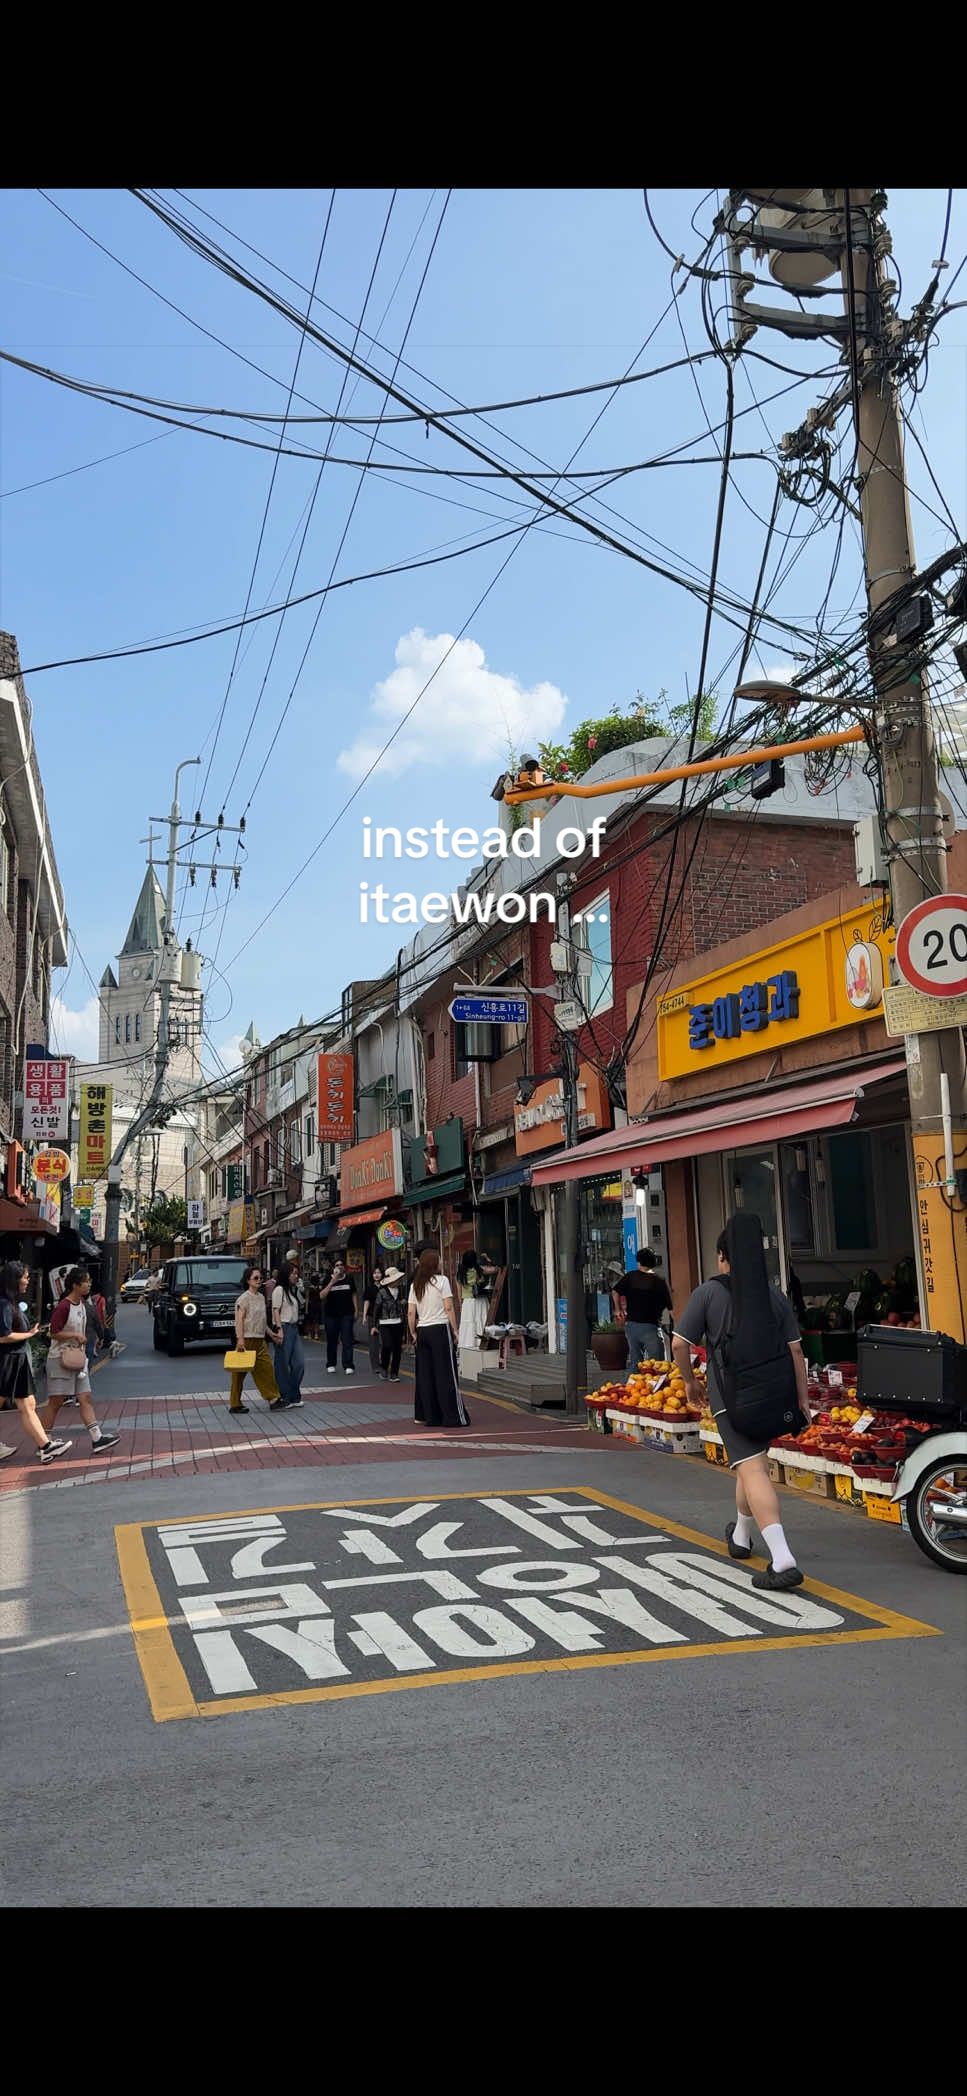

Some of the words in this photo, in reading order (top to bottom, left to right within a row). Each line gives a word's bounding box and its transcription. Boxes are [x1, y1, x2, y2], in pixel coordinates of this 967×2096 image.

[465, 1012, 505, 1022] Sinheung-ro
[688, 970, 801, 1050] 준이청과
[30, 1064, 63, 1078] 생활
[29, 1083, 63, 1097] 용품
[31, 1116, 60, 1129] 신발
[37, 1158, 66, 1173] 분식
[919, 1199, 935, 1294] 안심귀갓길
[157, 1495, 671, 1587] 귀갓길
[178, 1552, 845, 1695] 여성안심
